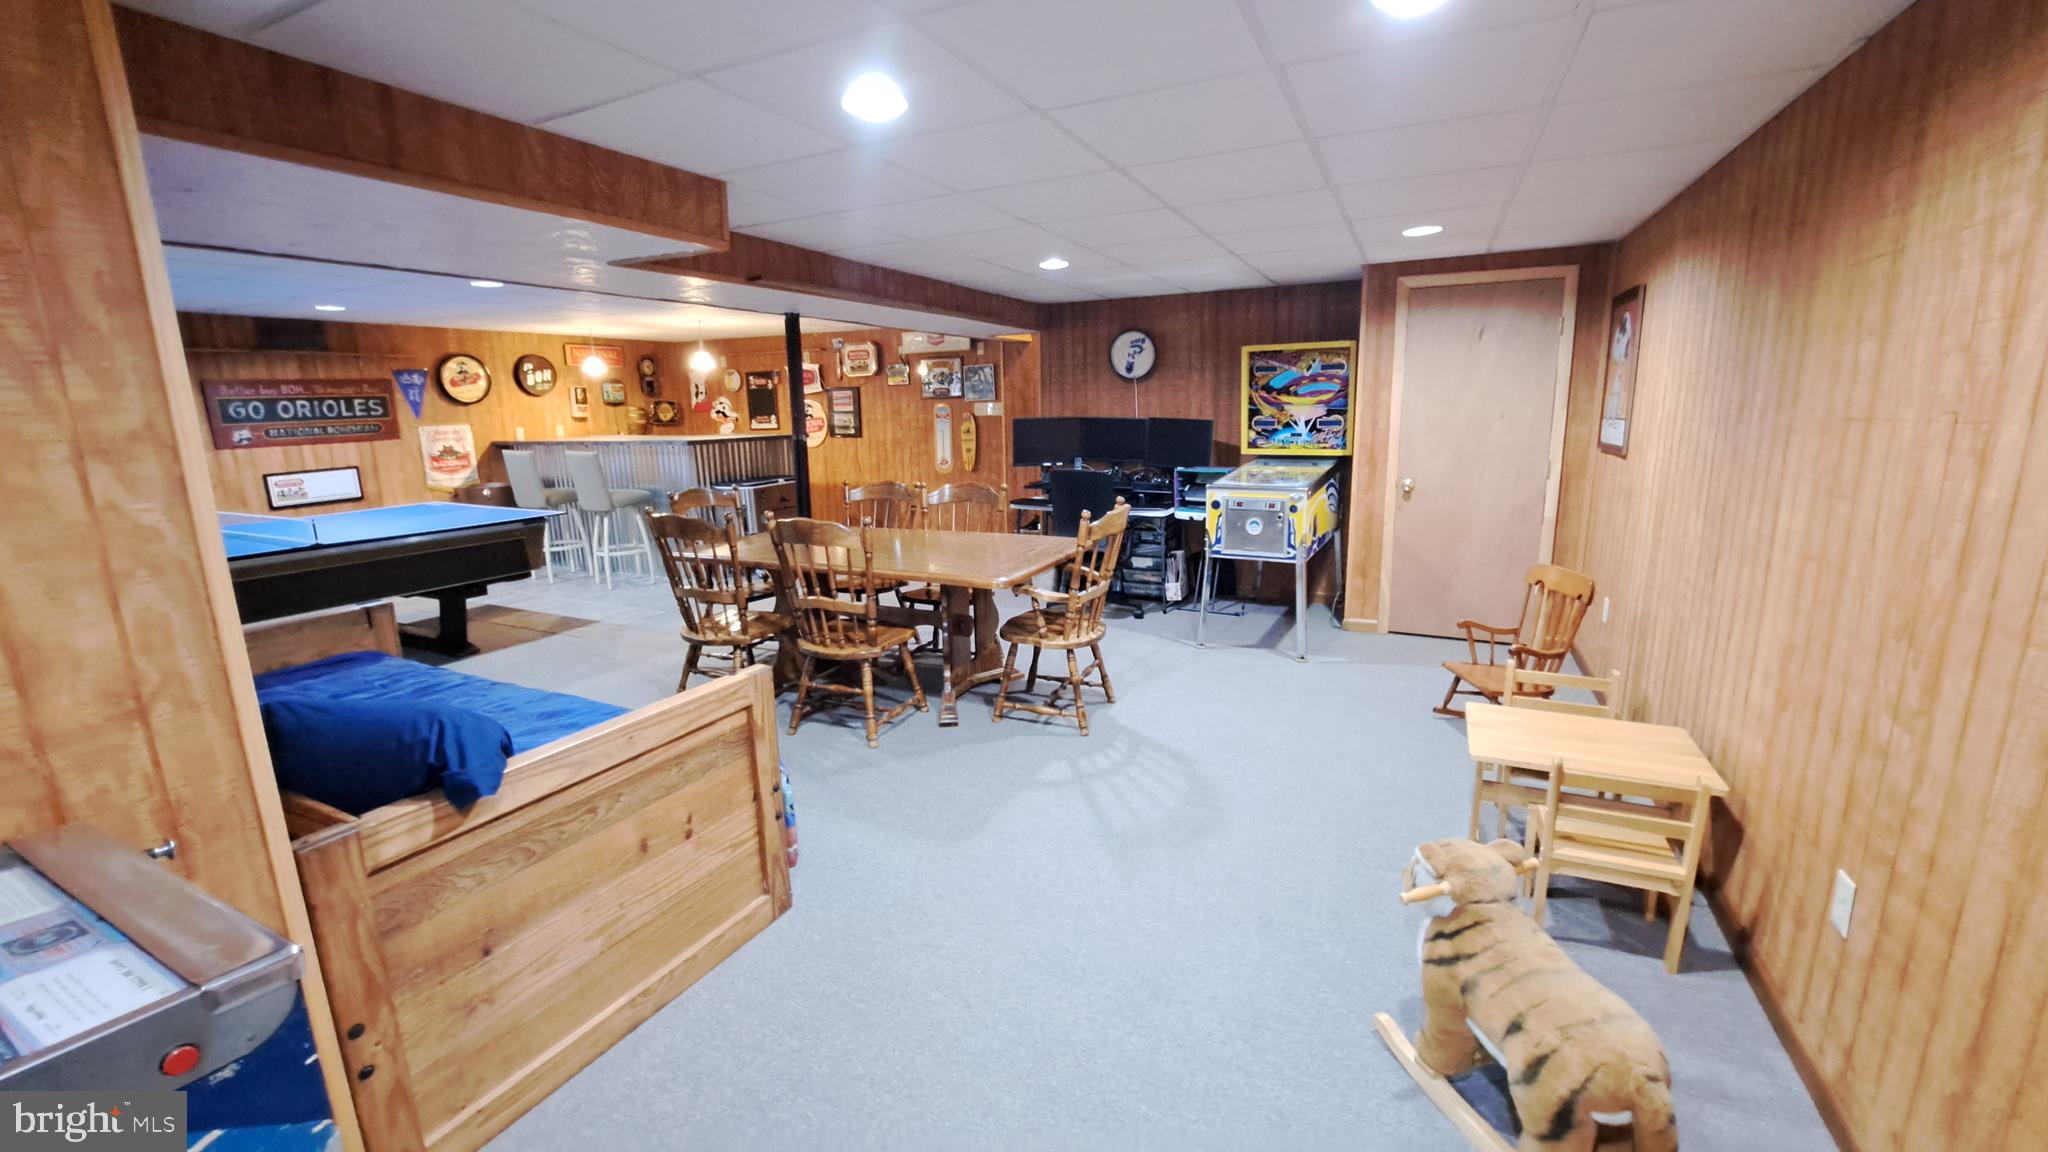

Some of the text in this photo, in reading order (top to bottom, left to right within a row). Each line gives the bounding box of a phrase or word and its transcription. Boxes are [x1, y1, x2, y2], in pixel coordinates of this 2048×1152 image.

[229, 399, 383, 419] GO ORIOLES
[269, 426, 325, 437] NATIONAL
